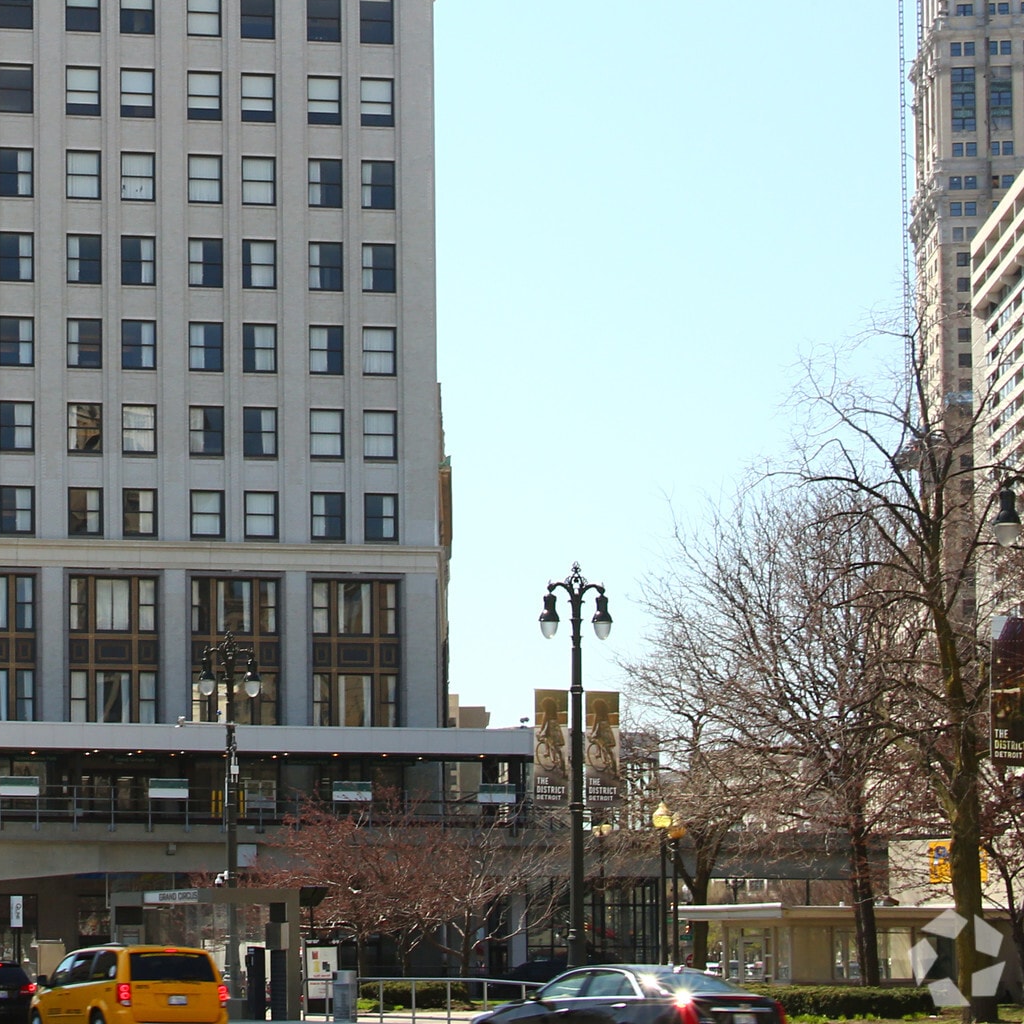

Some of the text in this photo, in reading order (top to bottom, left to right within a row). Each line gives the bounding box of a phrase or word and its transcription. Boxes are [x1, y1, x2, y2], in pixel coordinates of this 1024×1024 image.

[994, 728, 1009, 739] THE
[994, 751, 1023, 759] DETROIT
[537, 777, 549, 785] THE
[536, 786, 565, 794] DISTRICT
[588, 787, 617, 795] DISTRICT
[158, 892, 177, 901] GRAND
